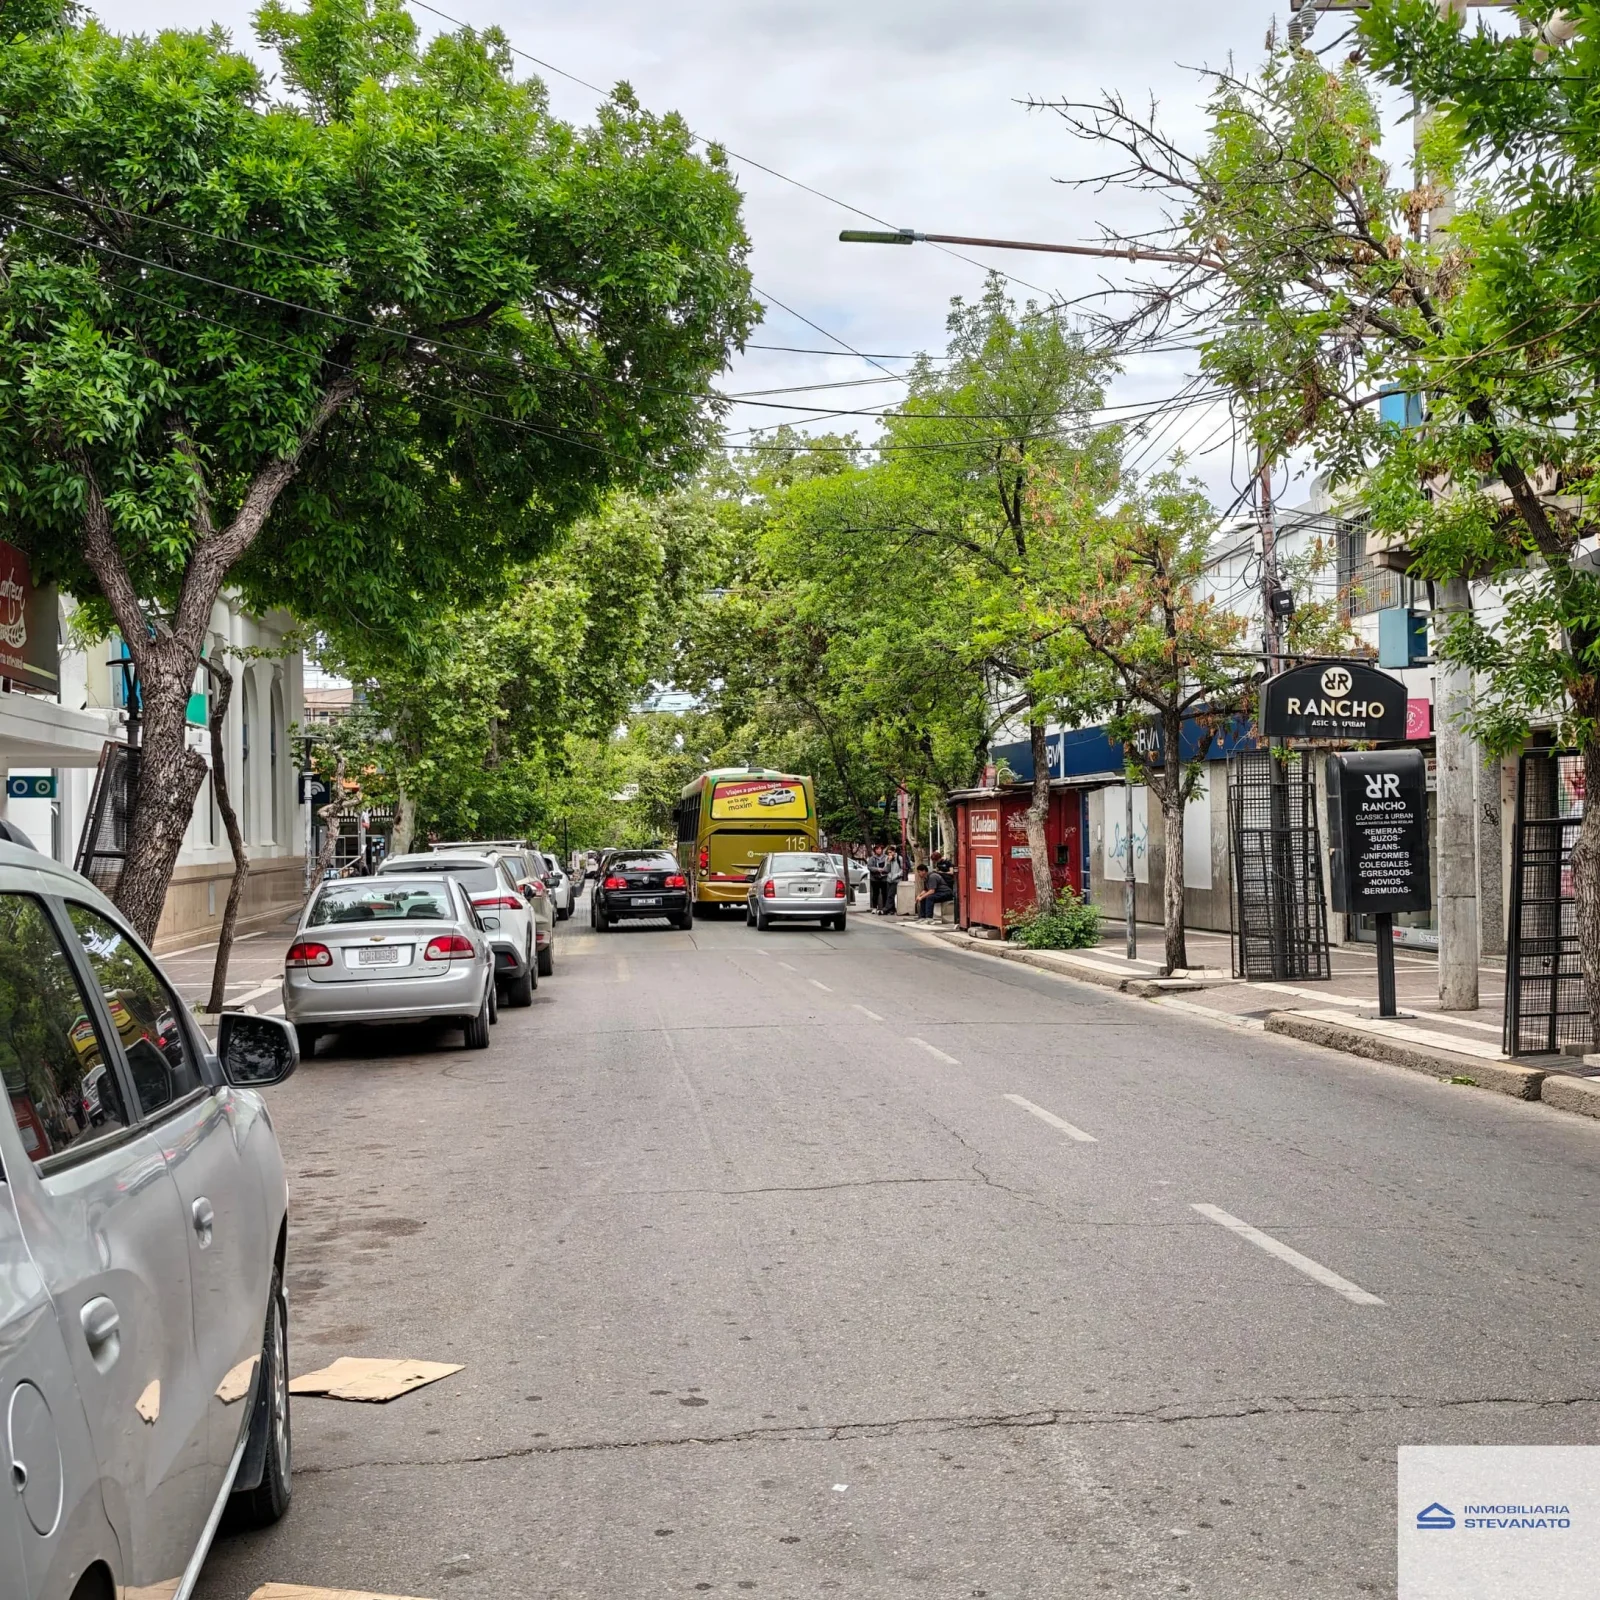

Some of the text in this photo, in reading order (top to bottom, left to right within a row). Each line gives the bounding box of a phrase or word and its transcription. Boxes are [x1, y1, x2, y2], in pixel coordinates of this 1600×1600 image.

[1287, 697, 1385, 718] RANCHO
[725, 788, 743, 796] Viajes
[747, 785, 767, 794] precios
[767, 782, 782, 790] bajos
[728, 801, 753, 811] maxim
[1362, 801, 1406, 811] RANCHO
[1362, 827, 1406, 835] -REMERAS-
[1368, 834, 1401, 842] -BUZOS-
[785, 836, 806, 851] 115
[1369, 843, 1401, 851] -JEANS-
[1361, 851, 1410, 860] -UNIFORMES
[1359, 860, 1412, 869] COLEGIALES-
[1358, 869, 1414, 877] -EGRESADOS-
[1368, 878, 1404, 886] -NOVIOS-
[1362, 886, 1412, 895] -BERMUDAS-
[360, 950, 376, 961] MPR
